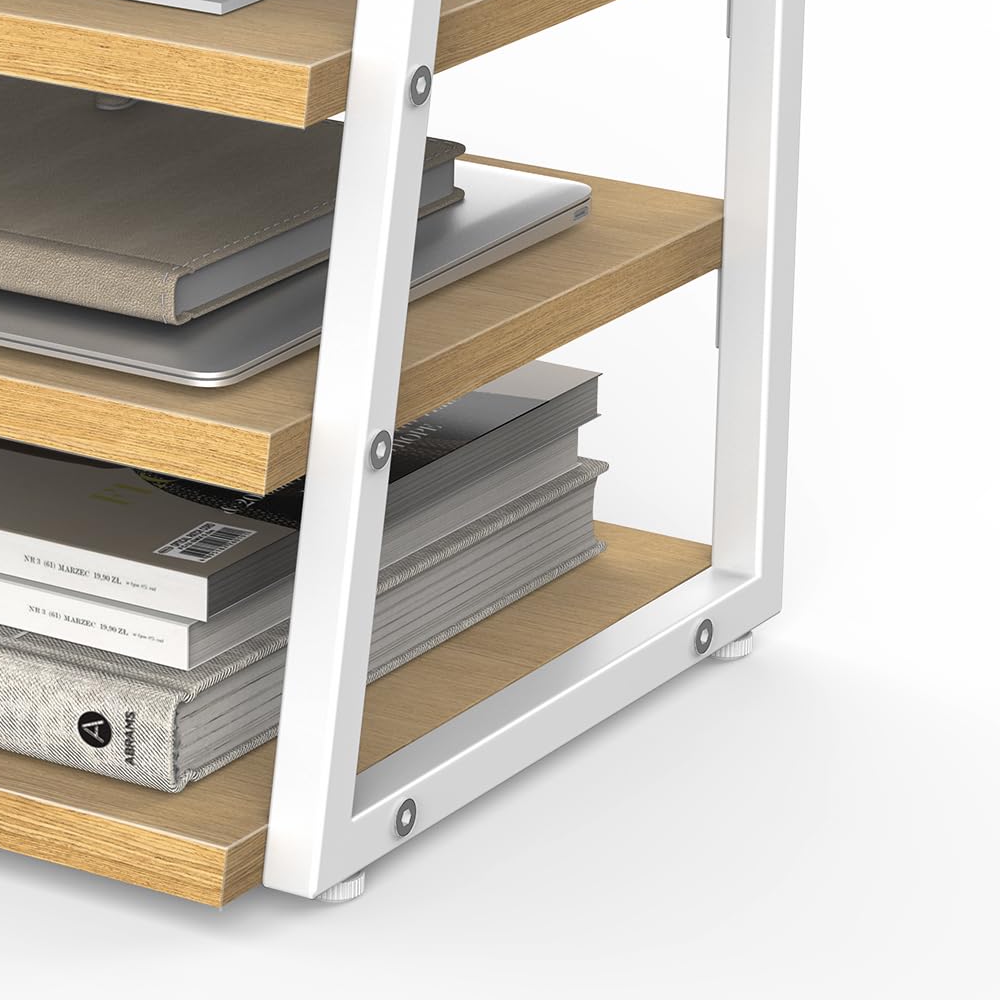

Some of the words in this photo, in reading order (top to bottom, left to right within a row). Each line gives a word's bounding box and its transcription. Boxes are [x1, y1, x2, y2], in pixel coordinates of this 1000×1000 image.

[57, 564, 91, 578] MARZEC
[63, 614, 97, 630] MARZEC
[124, 711, 136, 766] ABRAMS
